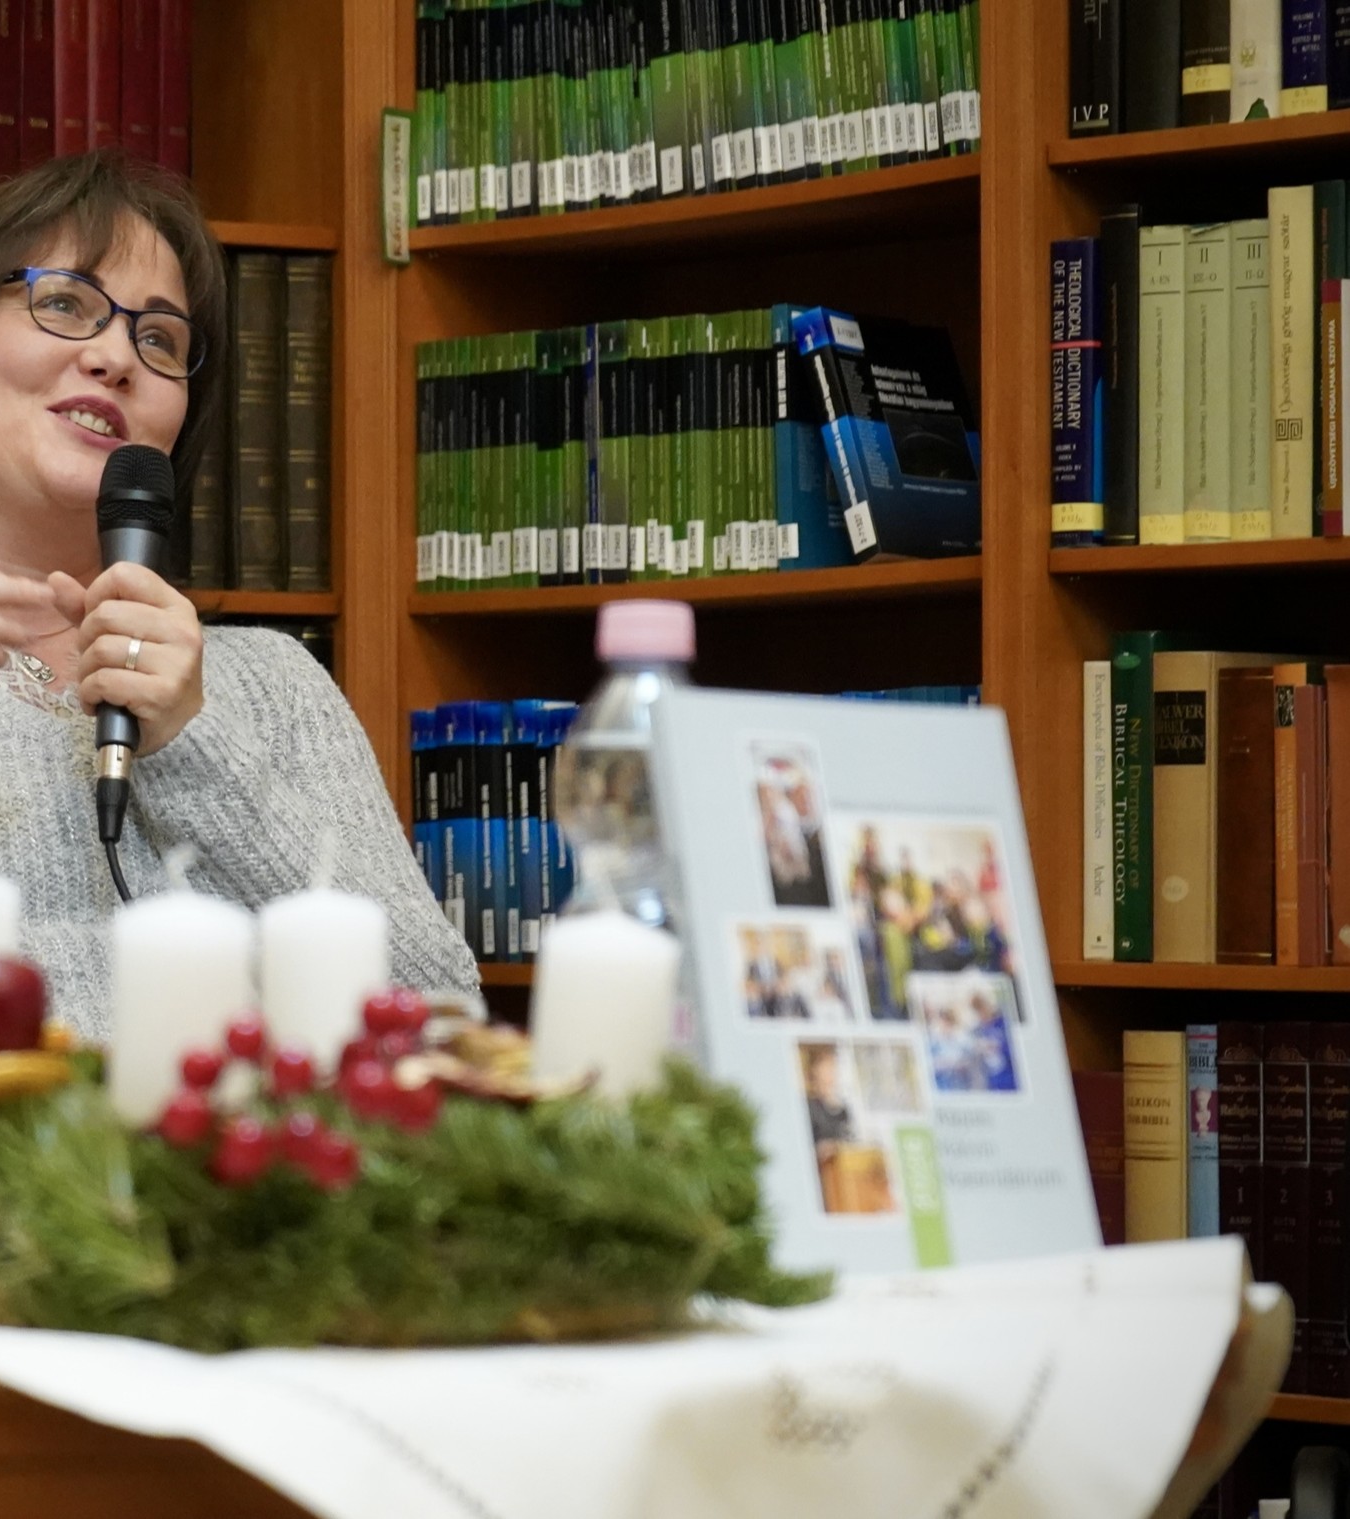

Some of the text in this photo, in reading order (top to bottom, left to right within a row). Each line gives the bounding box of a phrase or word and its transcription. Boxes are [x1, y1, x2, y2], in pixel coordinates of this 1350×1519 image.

[1073, 104, 1109, 122] IVP
[1199, 247, 1209, 263] II
[1247, 243, 1261, 260] III
[1052, 260, 1065, 430] OF THE NEW TESTAMENT
[1067, 259, 1082, 429] THEOLOGICAL DICTIONARY
[1156, 704, 1204, 719] ALWER
[1128, 718, 1141, 756] NEW
[1113, 704, 1127, 906] BIBLICAL THEOLOGY
[1128, 764, 1142, 863] DICTIONARY
[1127, 1097, 1170, 1108] LEXIKON
